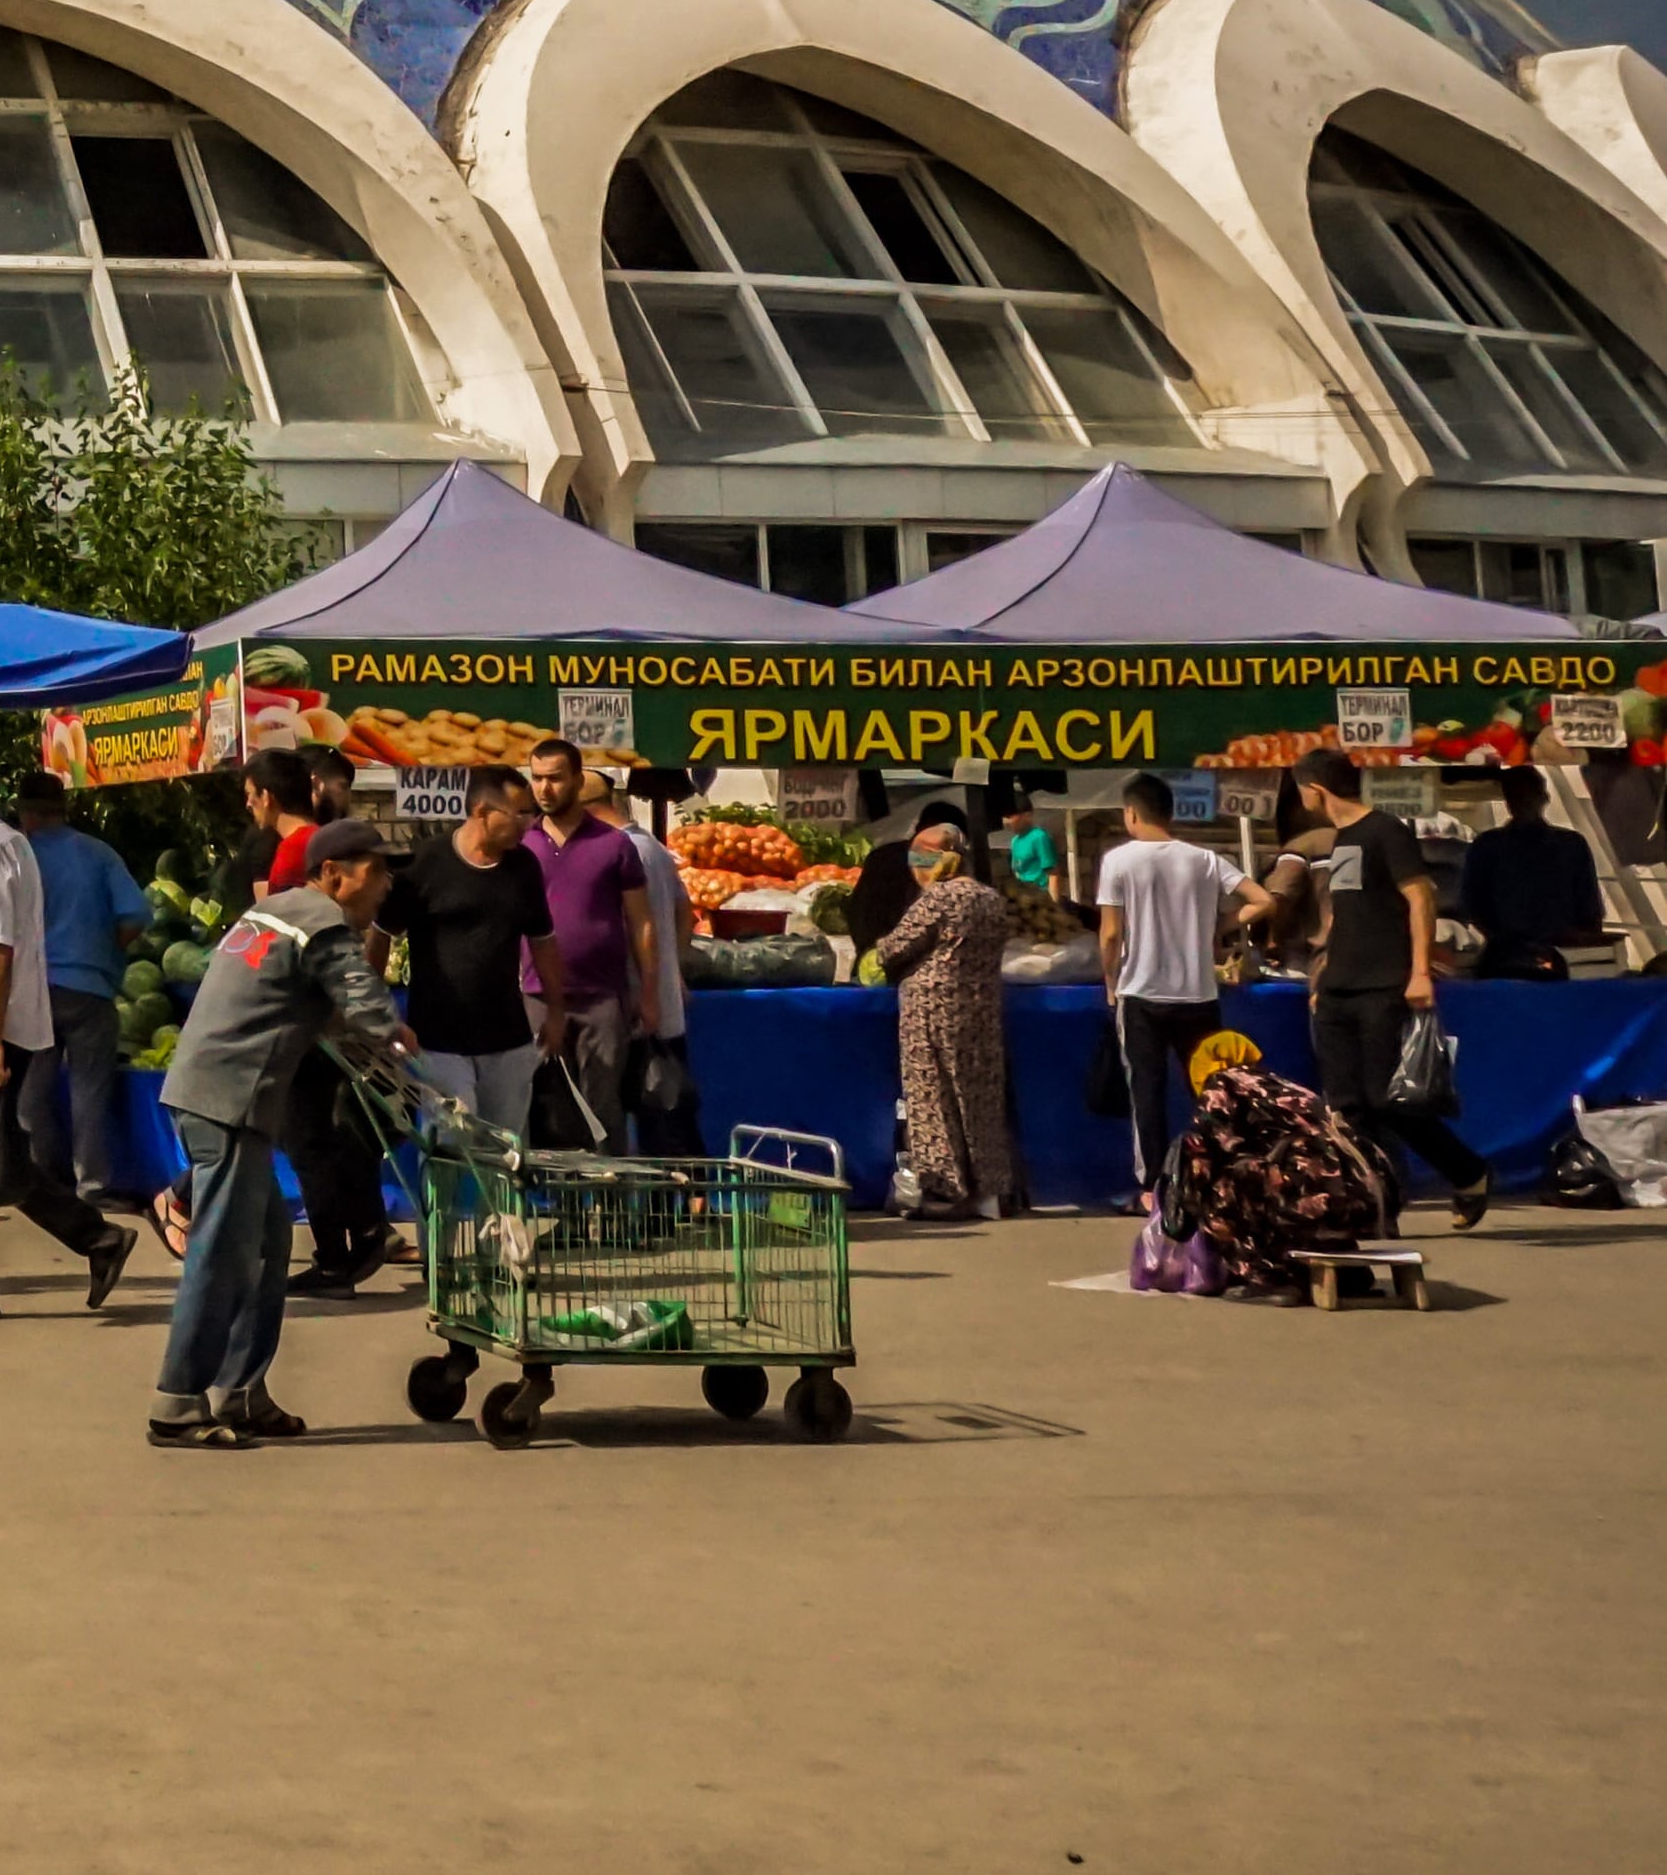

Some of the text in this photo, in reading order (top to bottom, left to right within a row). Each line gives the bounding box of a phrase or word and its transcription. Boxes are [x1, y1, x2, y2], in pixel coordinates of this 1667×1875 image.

[331, 653, 1616, 689] РАМАЗОН МУНОСАБАТИ БИЛАН АРЗОНЛАШТИРИЛГАН САВДО
[82, 690, 199, 725] АРЗОНЛАШТИРИЛГАН САВДО
[1339, 695, 1407, 716] ТЕРМИНАЛ
[689, 708, 1156, 761] ЯРМАРКАСИ
[1342, 722, 1383, 742] БОР
[1561, 722, 1616, 743] 2200
[94, 726, 178, 765] ЯРМАРКАСИ
[401, 766, 466, 791] КАРАМ
[402, 794, 462, 815] 4000
[784, 800, 846, 819] 2000
